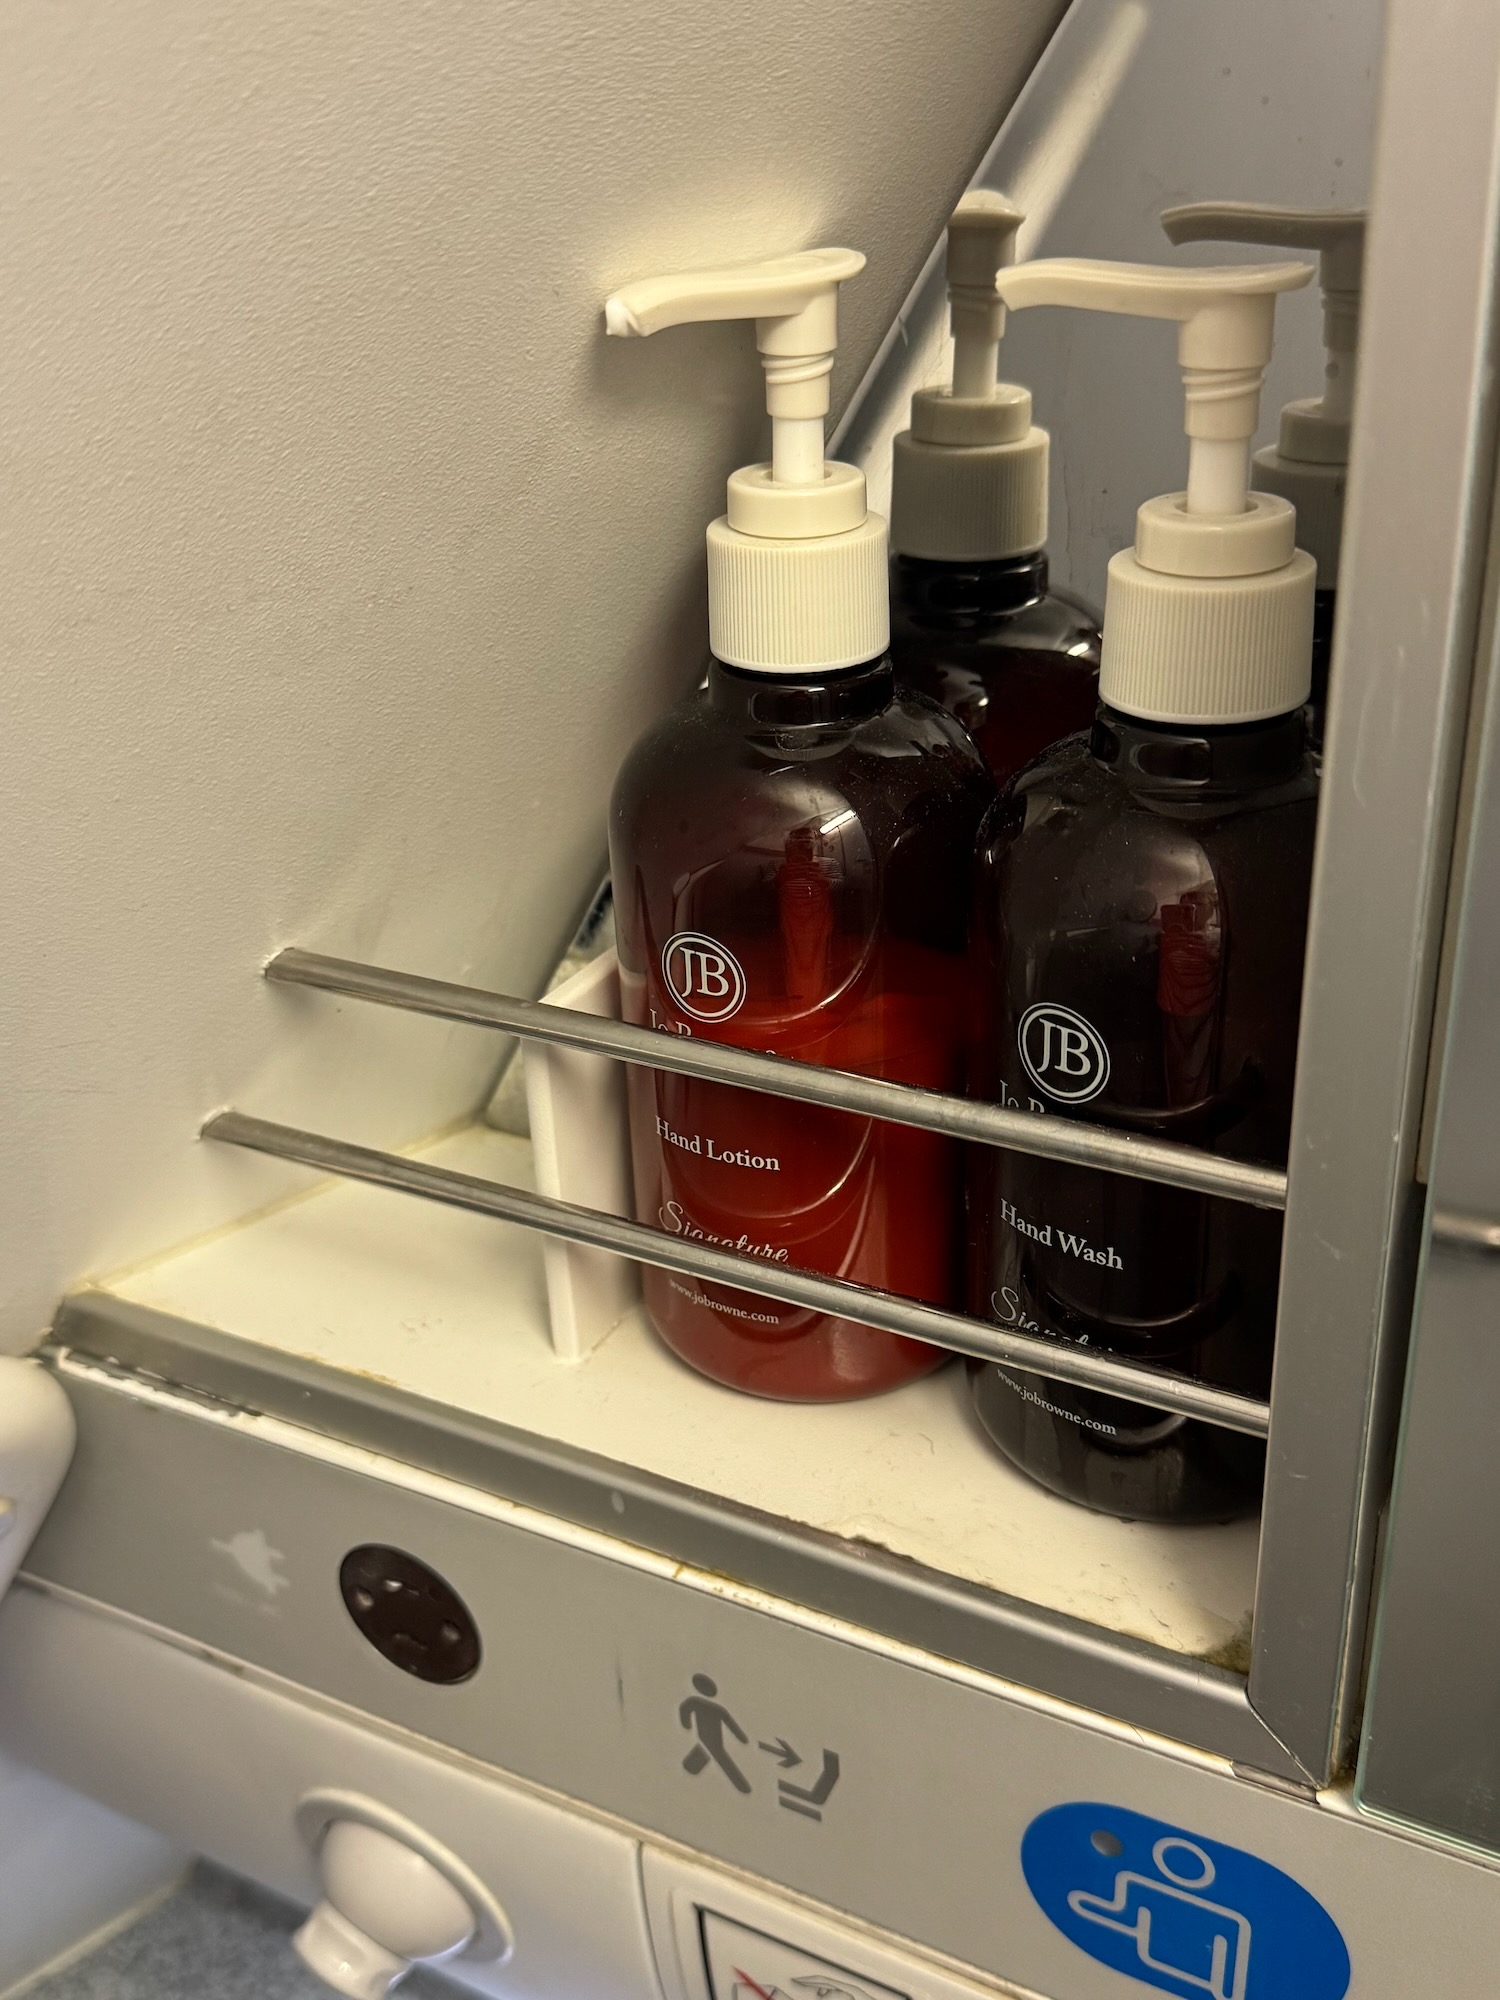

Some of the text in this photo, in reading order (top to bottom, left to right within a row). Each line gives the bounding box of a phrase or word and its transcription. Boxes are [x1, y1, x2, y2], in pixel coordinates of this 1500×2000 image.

[679, 946, 730, 998] JB
[1036, 1017, 1092, 1076] JB
[655, 1114, 781, 1171] Hand Lotion
[1000, 1197, 1124, 1271] Hand Wash
[669, 1279, 780, 1325] www.jobrowne.com
[996, 1368, 1117, 1436] www.jobrowne.com
